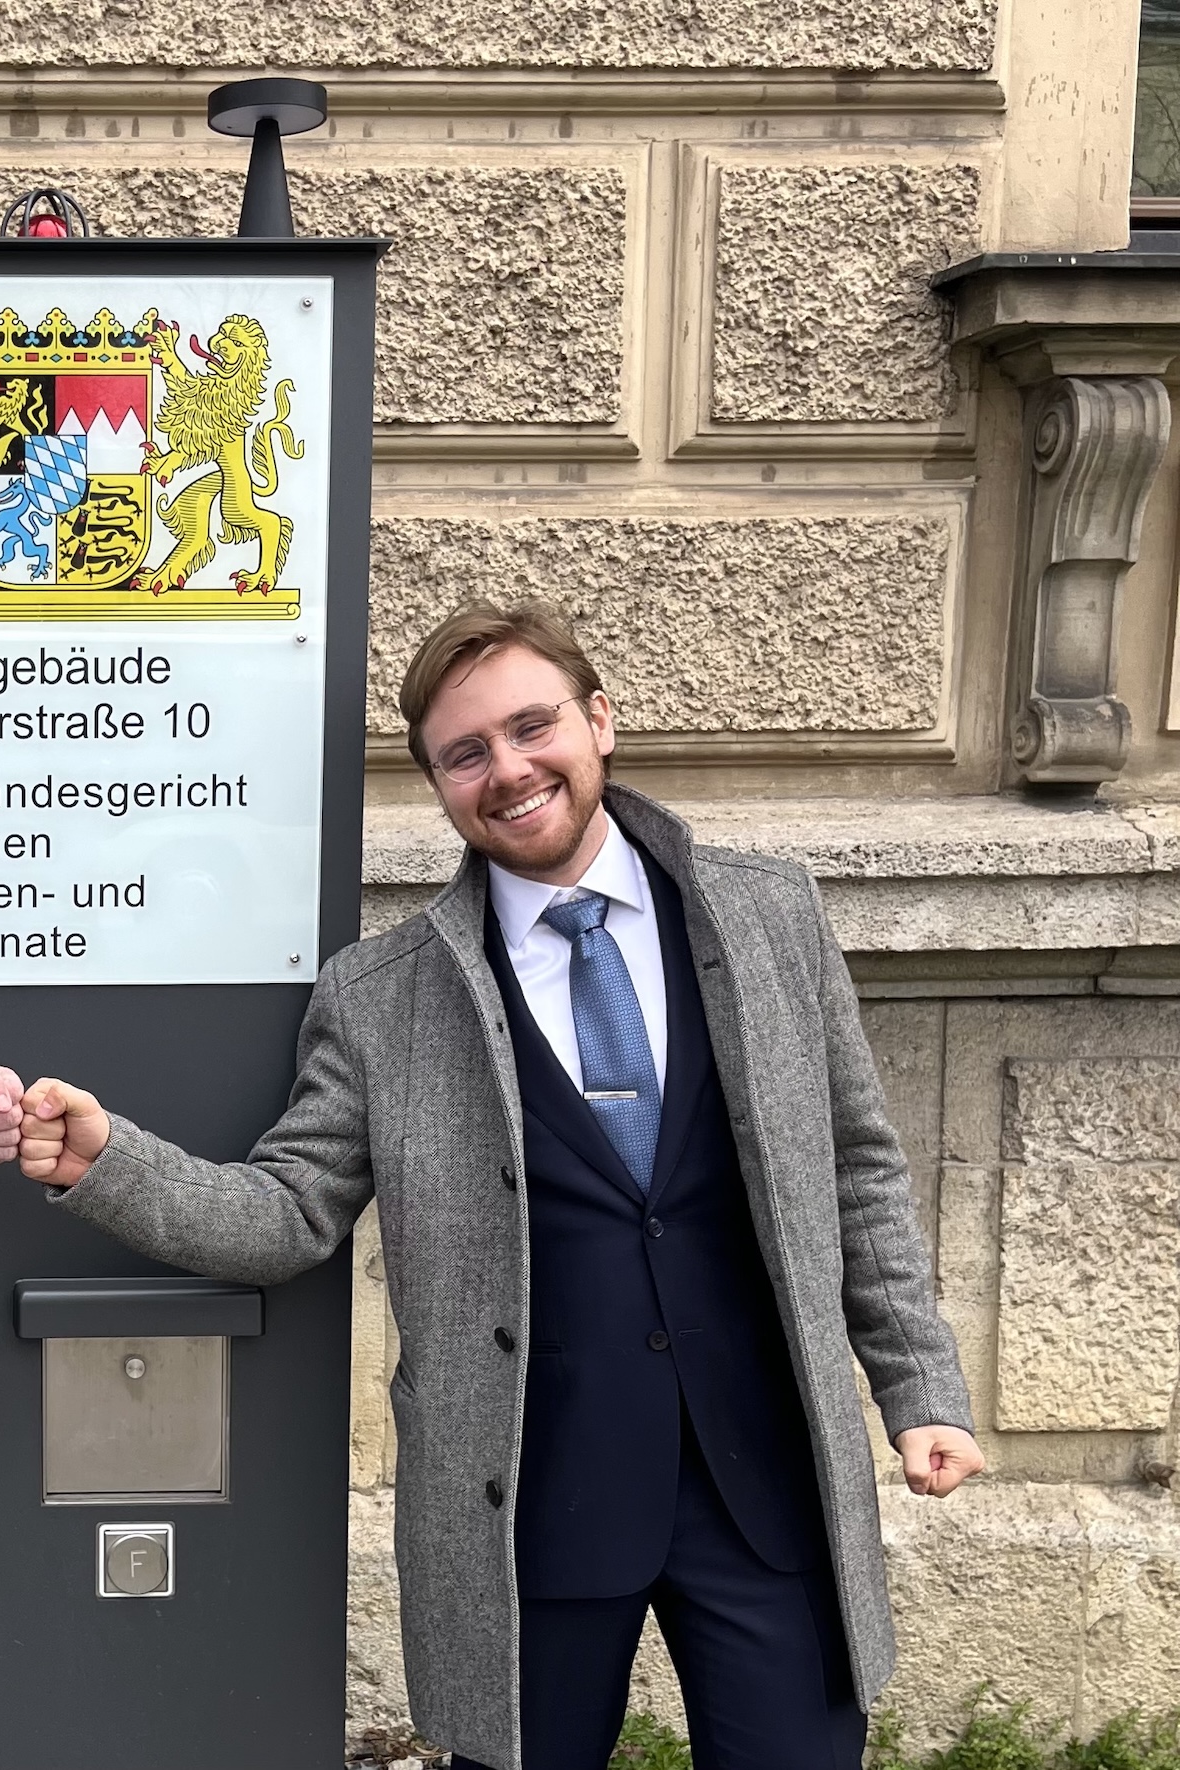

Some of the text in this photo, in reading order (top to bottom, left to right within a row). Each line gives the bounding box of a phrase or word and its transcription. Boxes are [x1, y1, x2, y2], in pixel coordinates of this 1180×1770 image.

[164, 702, 211, 739] 10
[73, 874, 145, 908] und
[130, 1550, 148, 1578] F
